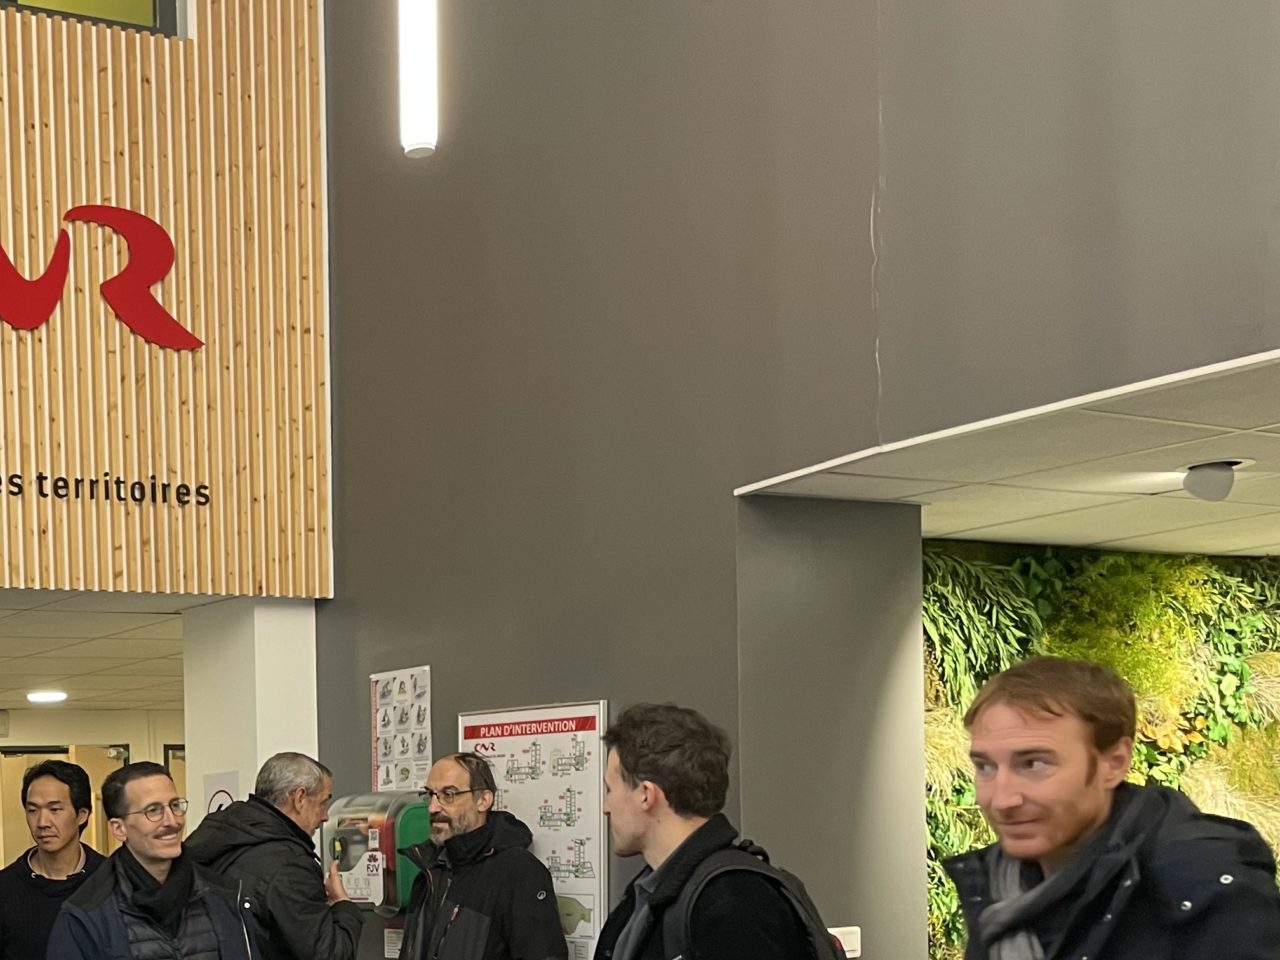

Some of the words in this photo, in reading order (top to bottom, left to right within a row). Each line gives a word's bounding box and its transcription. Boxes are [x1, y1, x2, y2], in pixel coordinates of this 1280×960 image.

[35, 470, 211, 507] territoires
[480, 726, 502, 737] PLAN
[503, 720, 576, 736] D'INTERVENTION
